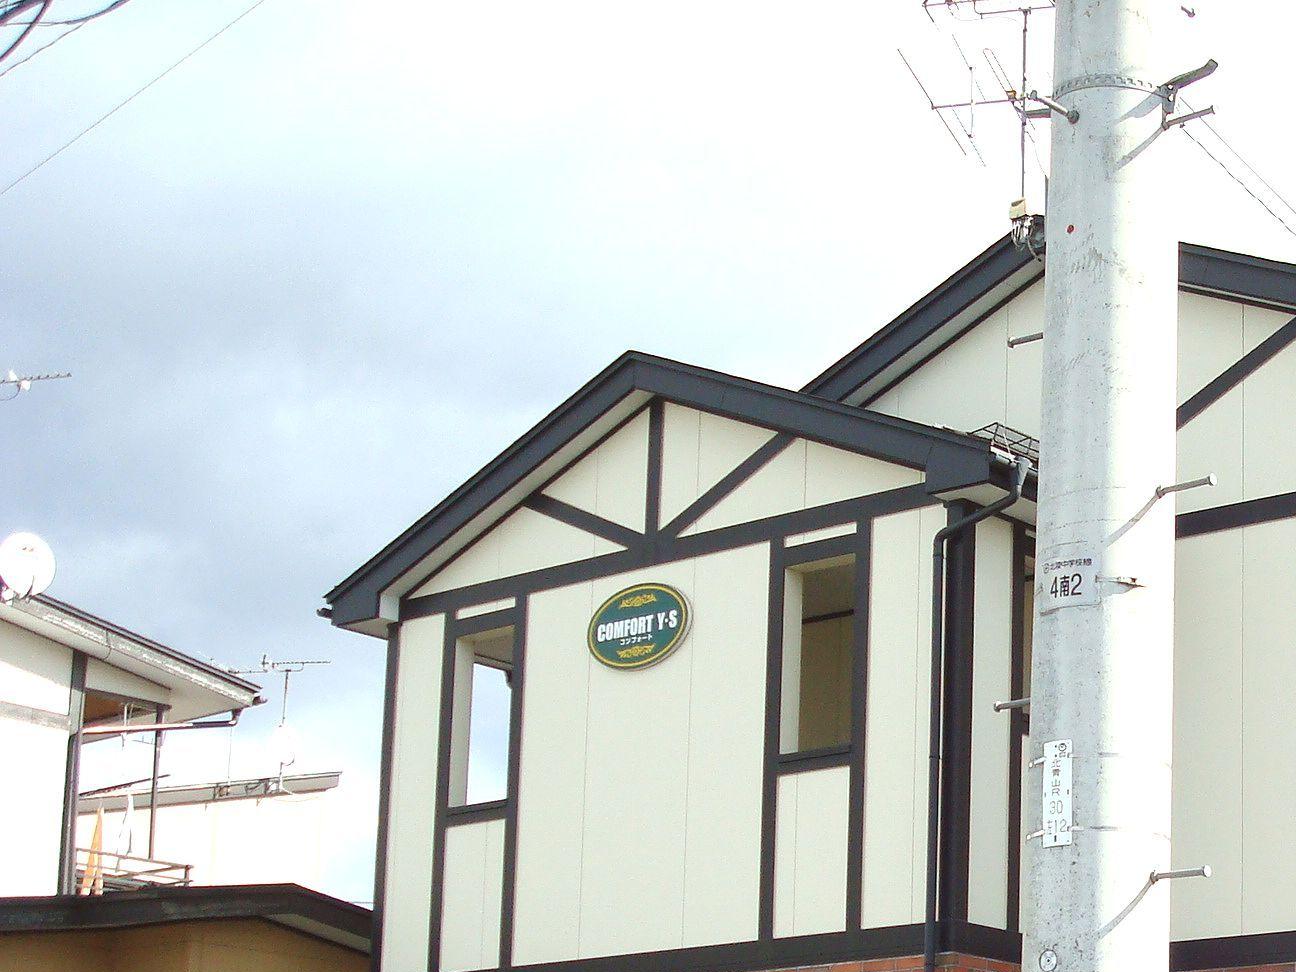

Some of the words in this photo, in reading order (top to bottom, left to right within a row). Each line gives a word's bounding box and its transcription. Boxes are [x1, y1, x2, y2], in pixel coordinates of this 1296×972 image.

[1050, 573, 1082, 599] 4南2
[597, 614, 654, 642] COMFORT
[620, 633, 653, 645] コンフォート
